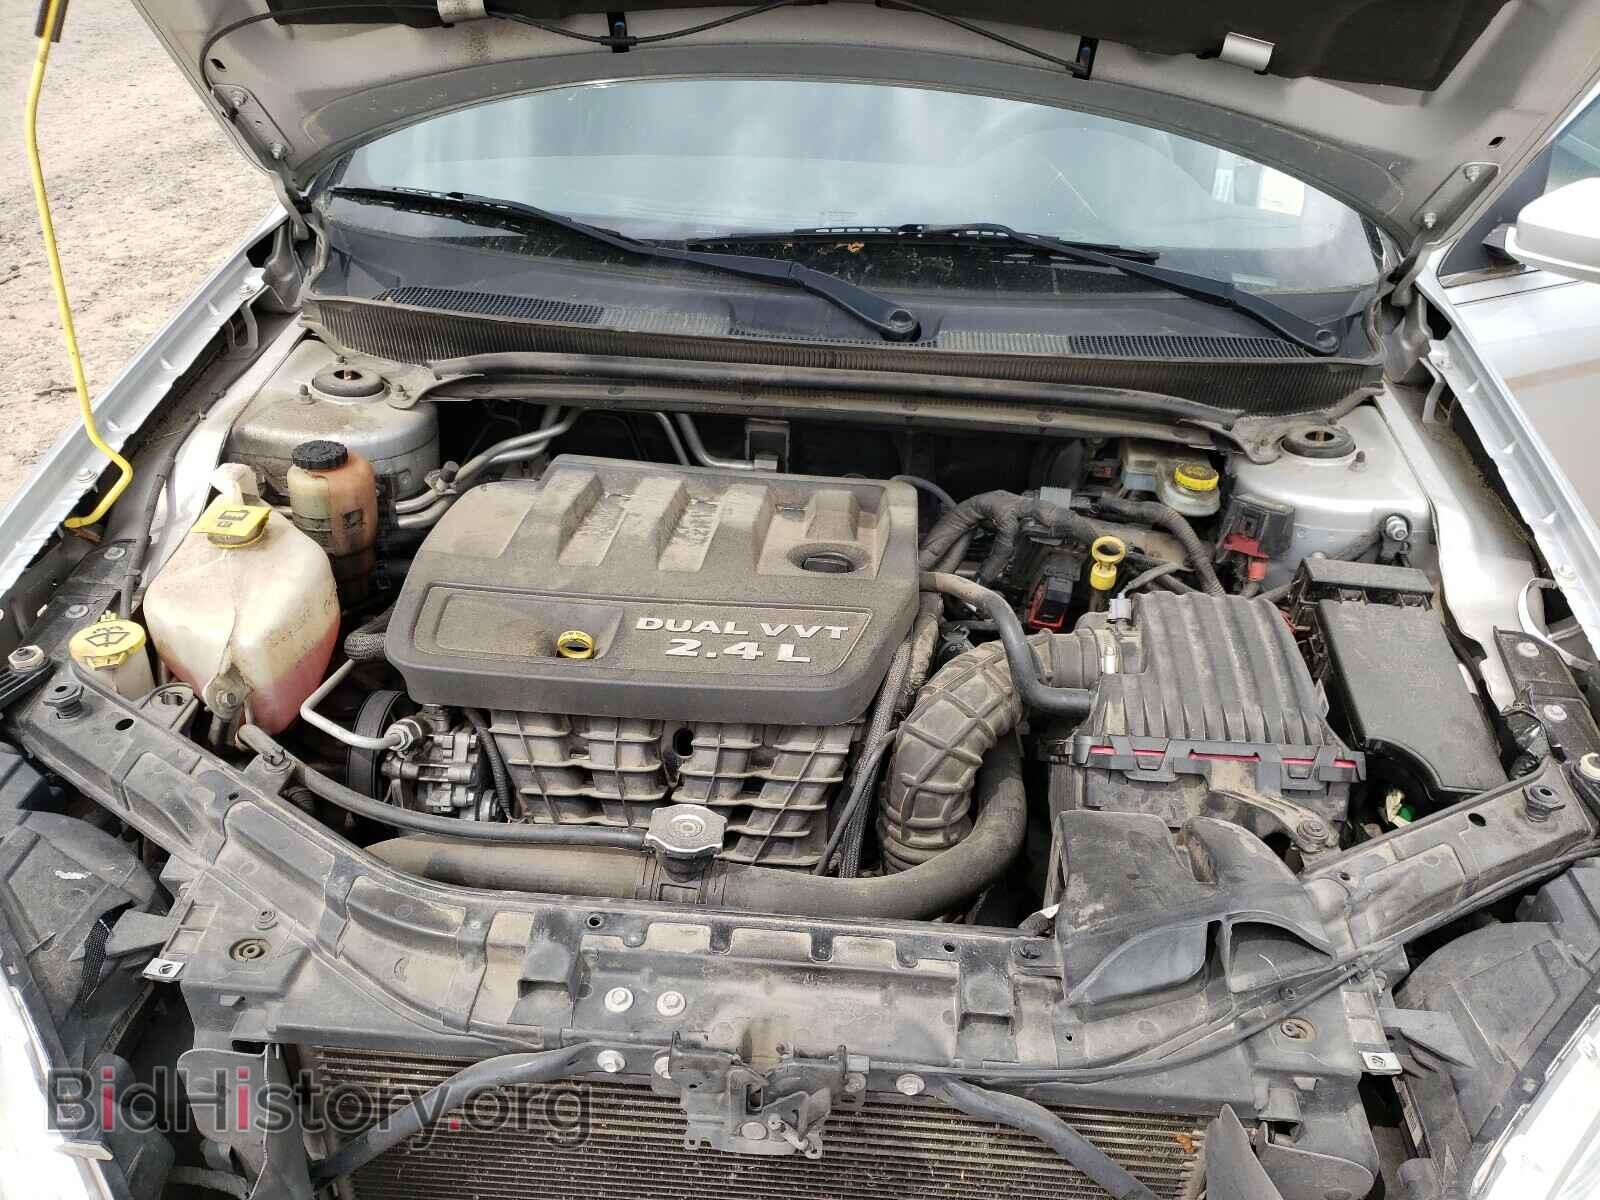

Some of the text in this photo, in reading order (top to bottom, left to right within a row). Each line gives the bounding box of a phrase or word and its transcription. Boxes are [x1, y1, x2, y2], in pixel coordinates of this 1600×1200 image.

[635, 617, 849, 640] DUAL VVT
[665, 638, 765, 661] 2.4
